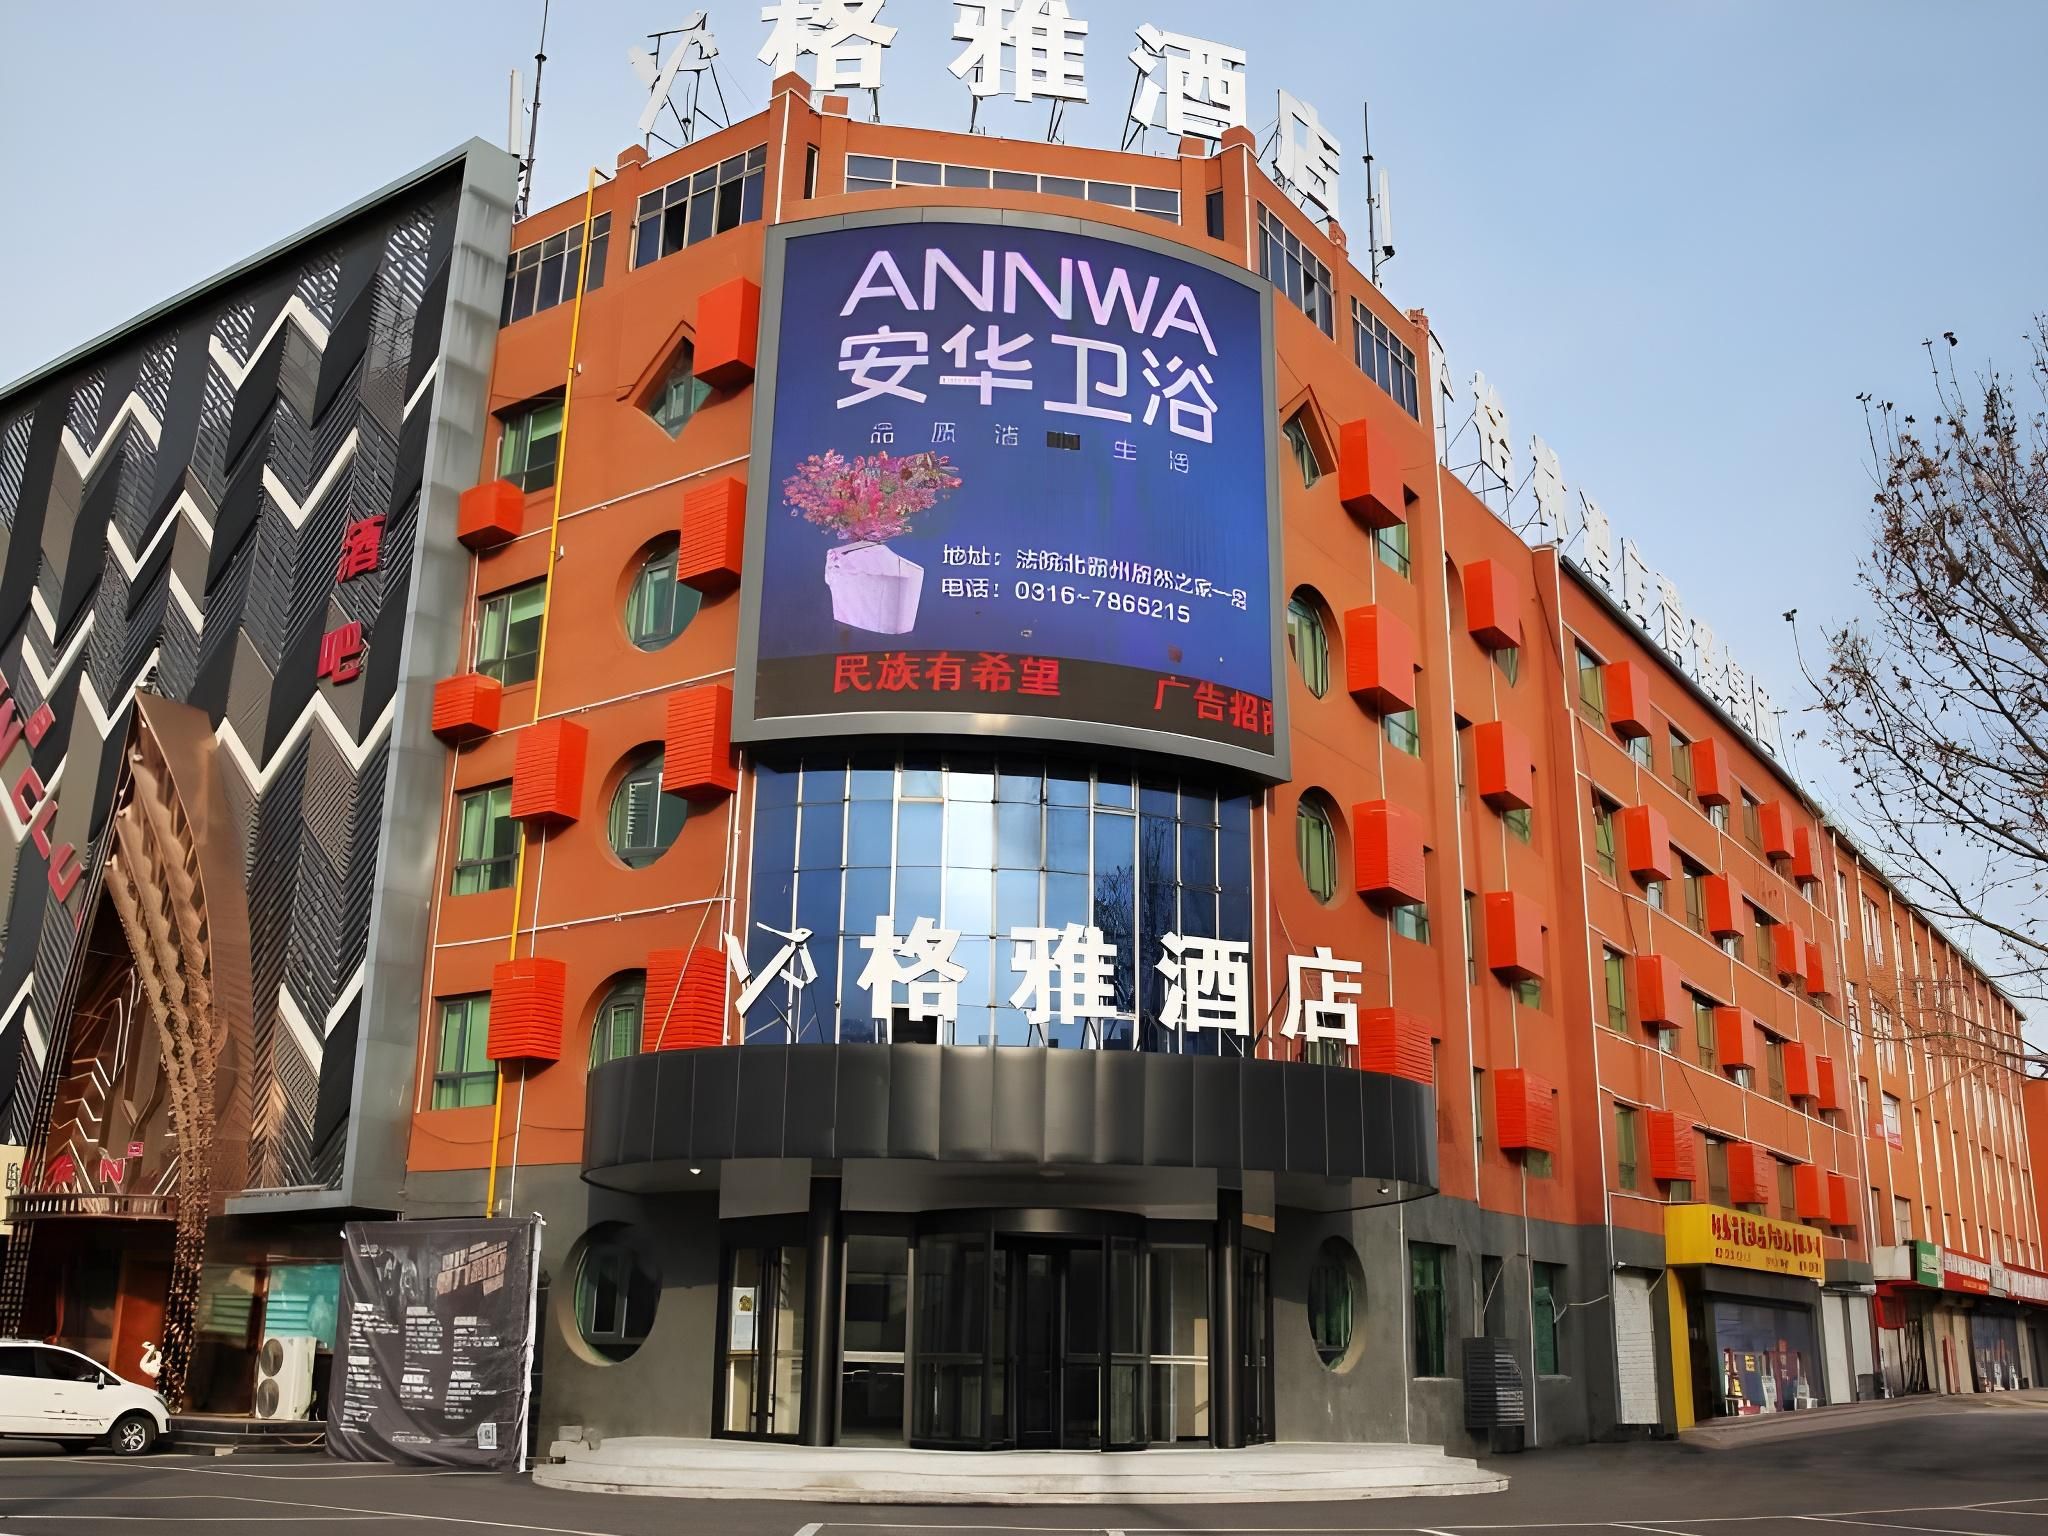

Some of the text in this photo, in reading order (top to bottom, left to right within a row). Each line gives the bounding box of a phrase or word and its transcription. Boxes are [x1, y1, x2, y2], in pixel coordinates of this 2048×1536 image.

[840, 248, 1217, 357] ANNWA
[836, 324, 1218, 444] 安华卫浴
[316, 514, 387, 686] 酒吧
[833, 652, 1061, 697] 民族有希望
